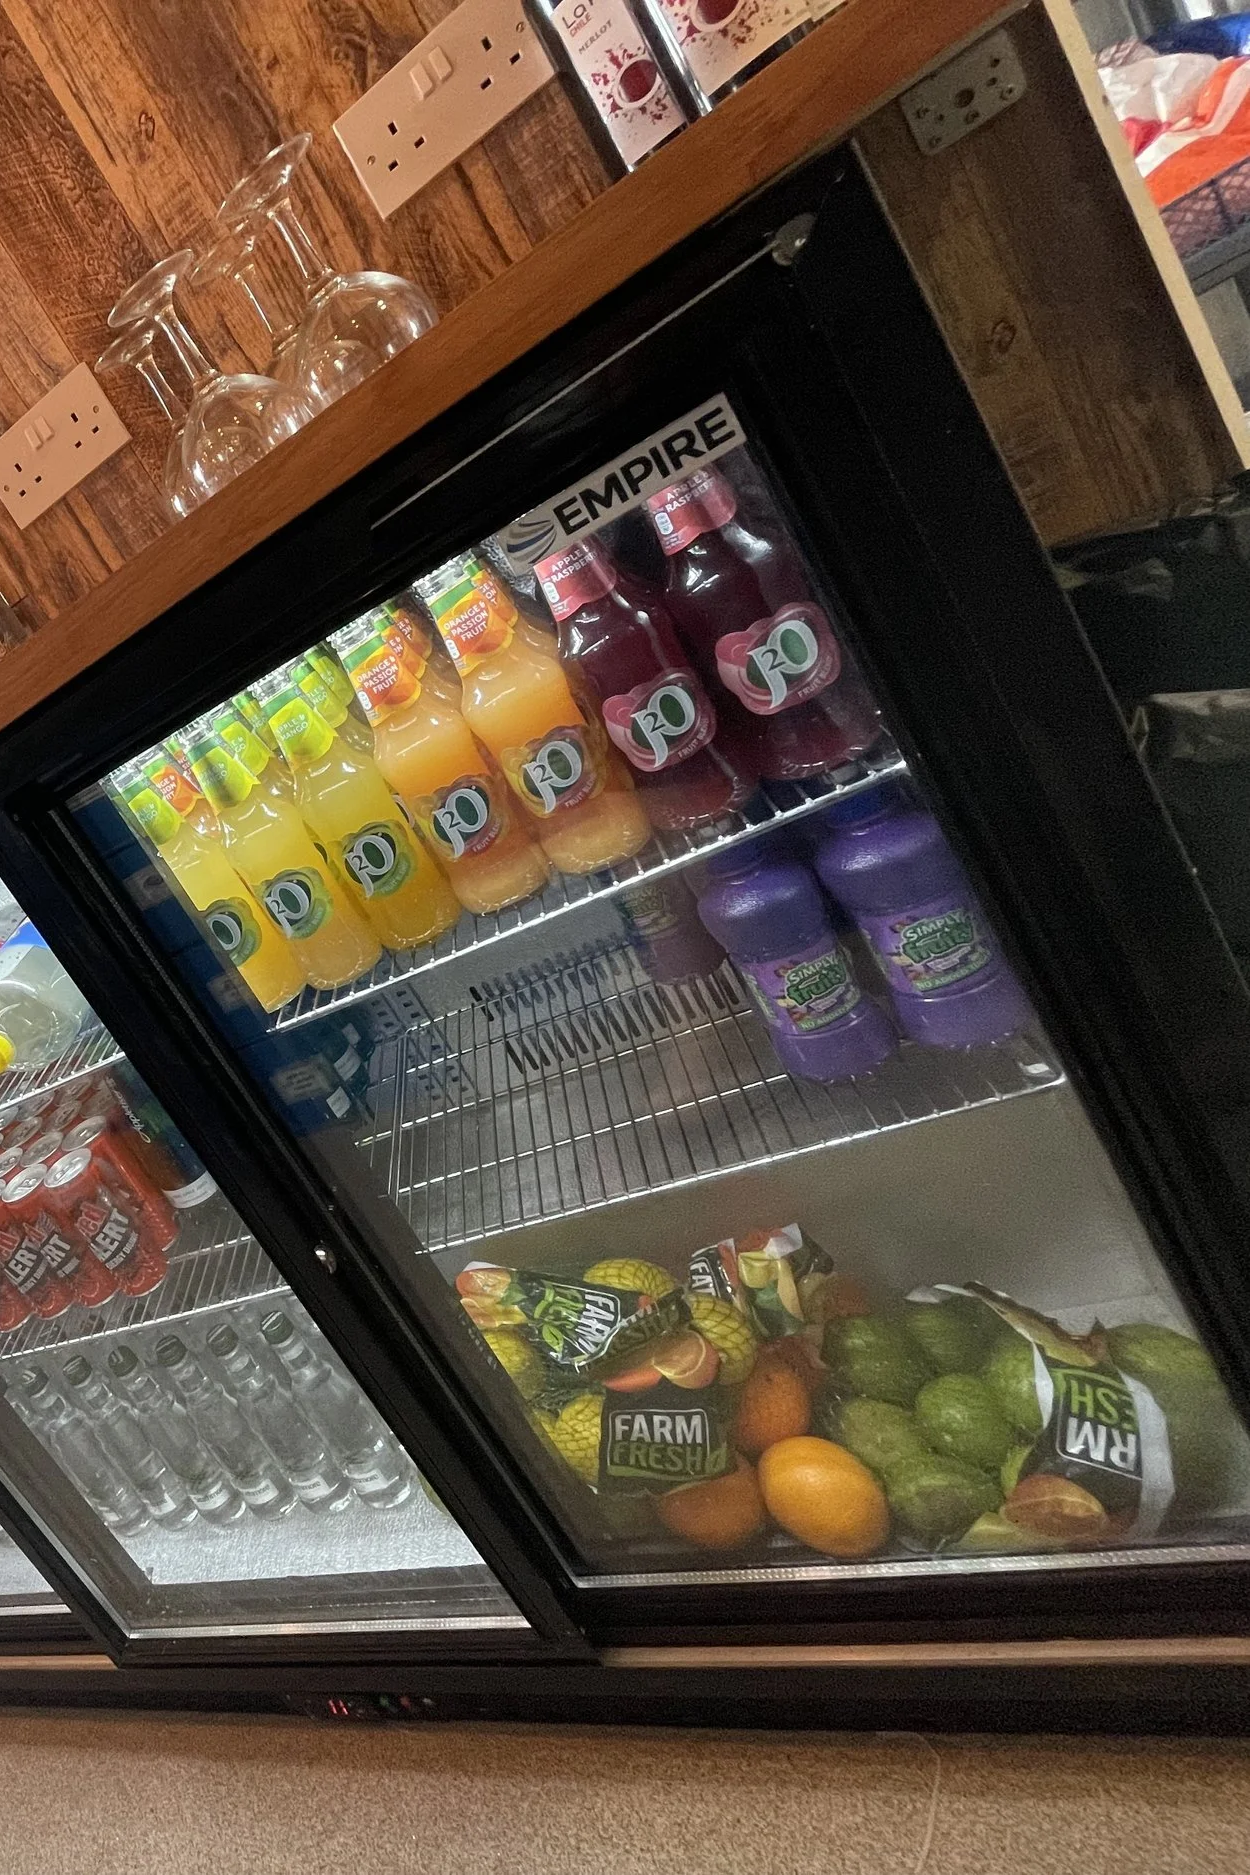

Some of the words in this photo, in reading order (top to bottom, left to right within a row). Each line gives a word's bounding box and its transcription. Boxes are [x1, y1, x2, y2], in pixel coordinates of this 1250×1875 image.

[570, 14, 592, 38] CHILE
[579, 19, 613, 53] MERLOT
[553, 407, 736, 535] EMPIRE
[666, 473, 703, 501] APPLE
[551, 550, 582, 573] APPLE
[444, 605, 480, 630] ORANGE
[451, 611, 488, 637] PASSION
[461, 621, 488, 641] FRUIT
[357, 660, 391, 683] ORANGE
[363, 664, 399, 688] PASSION
[372, 675, 397, 694] FRUIT
[677, 738, 700, 758] FRUIT
[904, 913, 967, 942] SIMPLY
[903, 922, 974, 964] fruity
[788, 953, 839, 985] SIMPLY
[787, 964, 847, 1005] fruity
[917, 979, 932, 990] NO
[801, 1020, 815, 1031] NO
[90, 1208, 129, 1262] LERT
[4, 1236, 40, 1285] LERT
[41, 1234, 70, 1268] ERT
[614, 1414, 701, 1444] FARM
[1066, 1417, 1136, 1471] RM
[613, 1444, 701, 1473] FRESH
